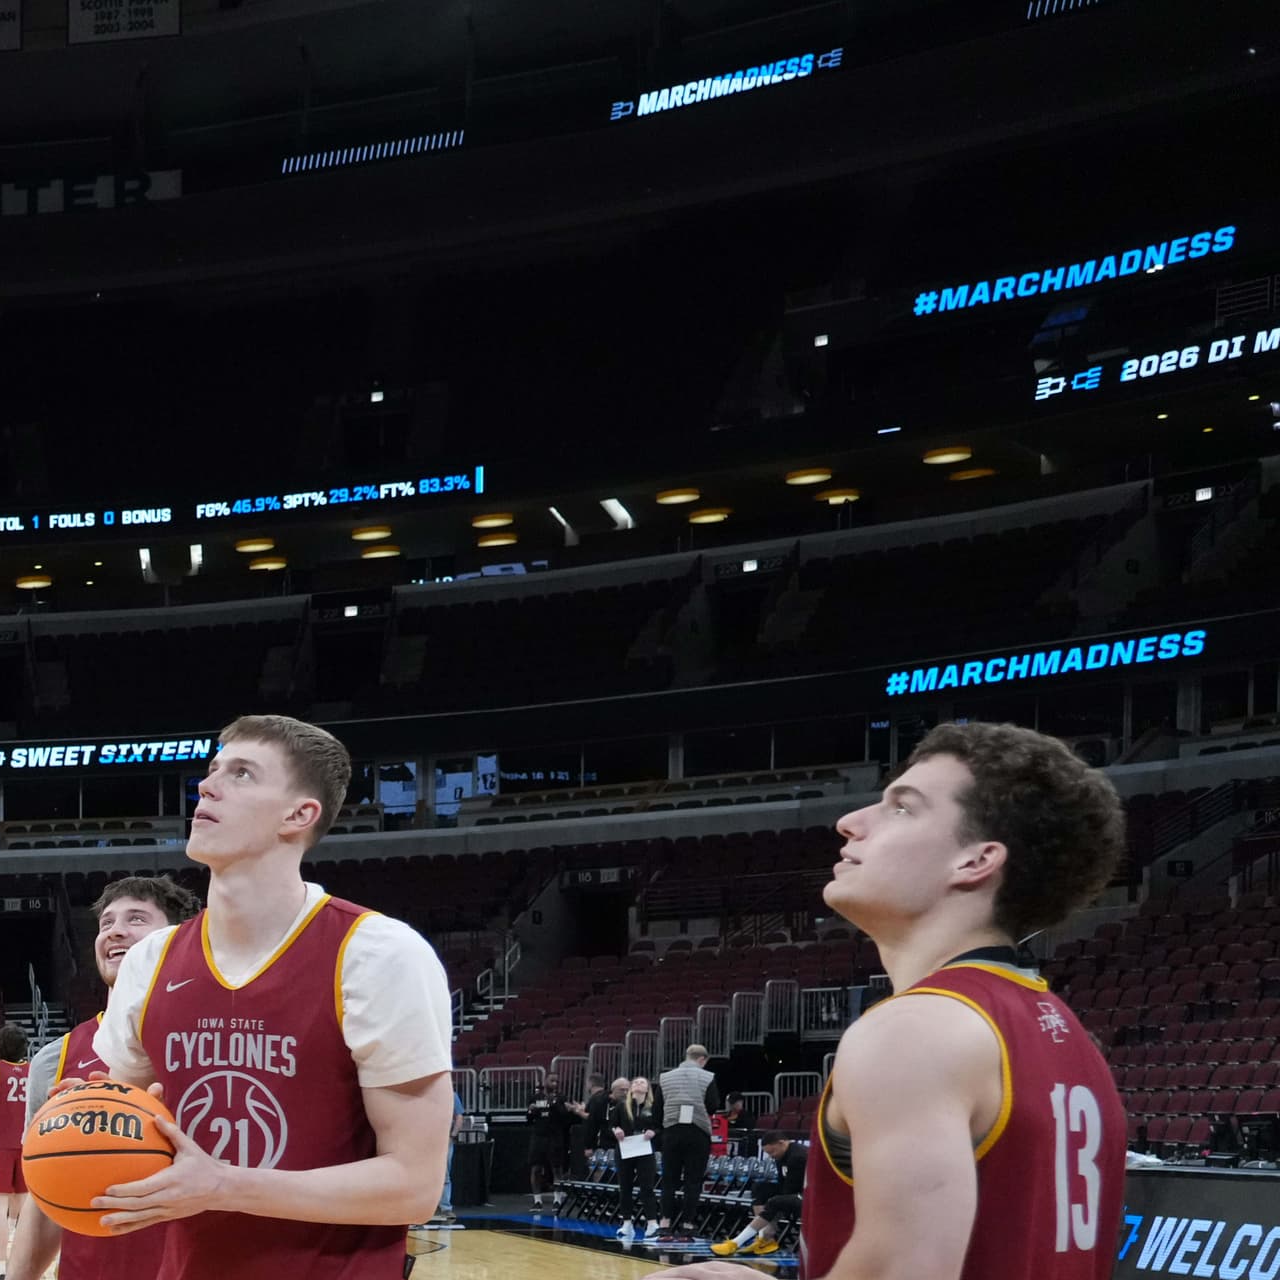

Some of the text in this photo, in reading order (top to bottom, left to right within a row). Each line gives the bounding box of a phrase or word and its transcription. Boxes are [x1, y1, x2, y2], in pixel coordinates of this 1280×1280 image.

[637, 54, 814, 116] MARCHMADNESS
[913, 226, 1236, 316] #MARCHMADNESS
[1120, 346, 1200, 382] 2026
[1208, 336, 1245, 363] DI
[32, 515, 39, 528] 1
[49, 513, 95, 528] FOULS
[122, 508, 171, 524] BONUS
[197, 502, 230, 518] FG%
[283, 491, 327, 509] 3PT%
[329, 485, 378, 504] 29.2%
[380, 482, 415, 499] FT%
[419, 475, 470, 494] 83.3%
[886, 630, 1206, 696] #MARCHMADNESS
[11, 739, 211, 768] SWEET SIXTEEN
[197, 1018, 264, 1031] IOWA STATE
[165, 1031, 297, 1078] CYCLONES
[7, 1077, 27, 1101] 23
[39, 1109, 144, 1141] Wilson
[209, 1118, 249, 1168] 21
[1051, 1083, 1101, 1253] 13
